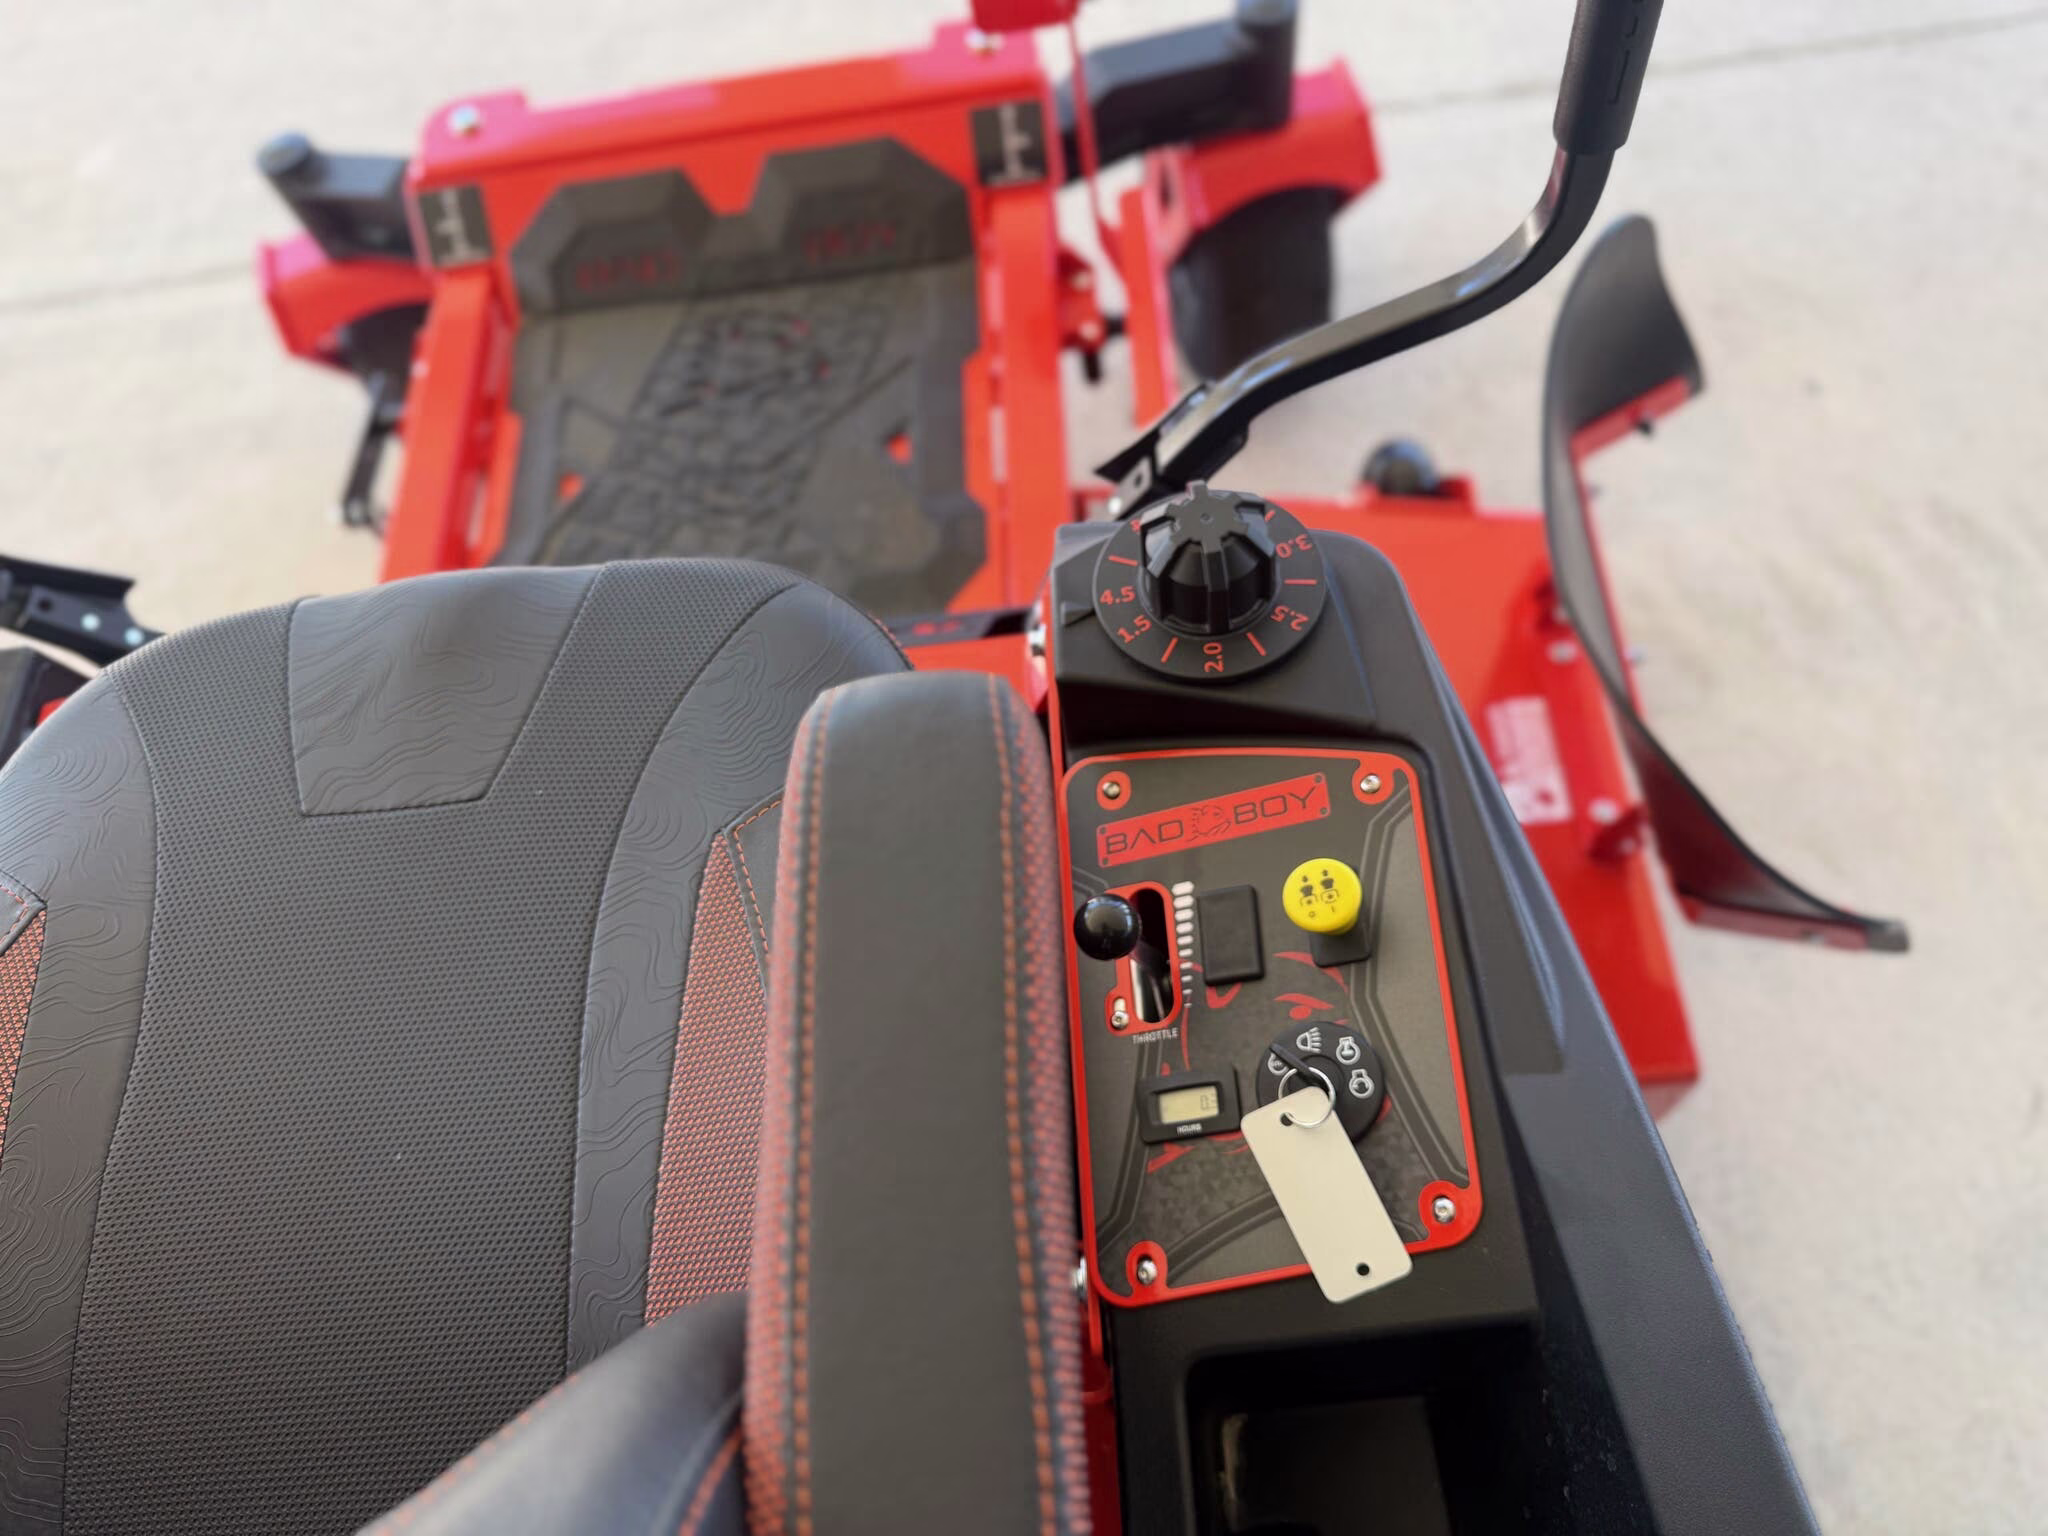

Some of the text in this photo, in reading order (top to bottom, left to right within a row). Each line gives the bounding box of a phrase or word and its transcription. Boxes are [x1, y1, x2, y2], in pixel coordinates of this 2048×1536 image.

[1275, 534, 1312, 559] 3.0
[1100, 585, 1136, 605] 4.5
[1117, 614, 1151, 643] 1.5
[1272, 605, 1309, 631] 2.5
[1203, 642, 1224, 672] 2.0
[1105, 786, 1316, 855] BAD BOY
[1132, 1027, 1179, 1044] THROTTLE
